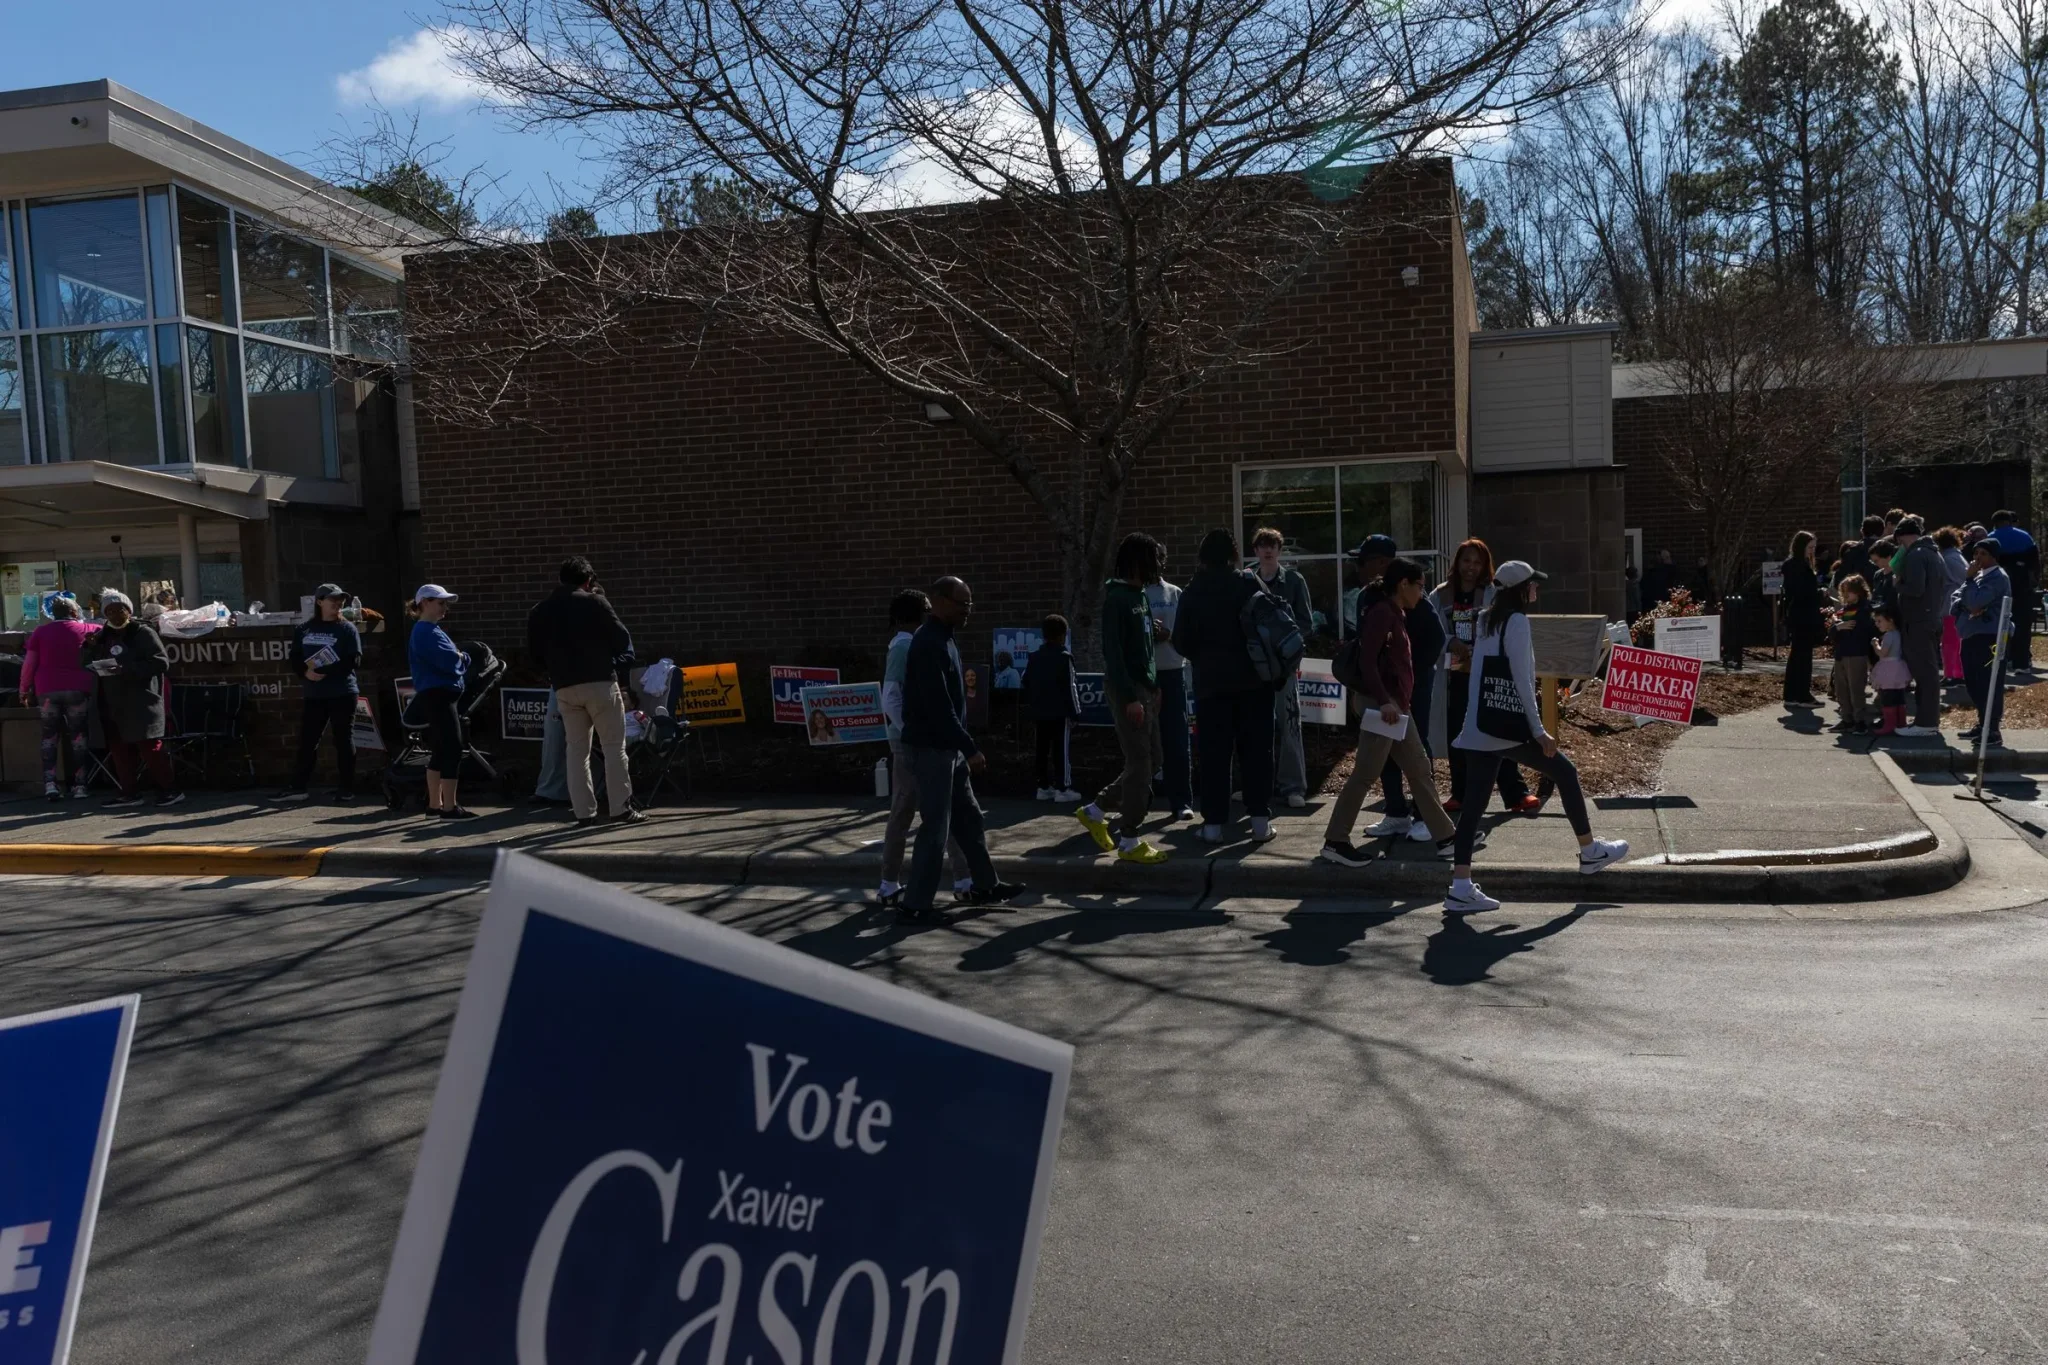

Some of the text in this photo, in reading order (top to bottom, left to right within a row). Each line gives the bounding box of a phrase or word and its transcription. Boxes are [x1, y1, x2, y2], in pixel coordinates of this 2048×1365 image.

[1613, 648, 1699, 674] POLL DISTANCE
[1608, 667, 1694, 701] MARKER
[809, 694, 874, 708] MORROW
[1305, 701, 1328, 709] SENATE
[1611, 689, 1686, 710] NO ELECTIONEERING
[1611, 701, 1683, 721] BEYOND THIS POINT
[832, 716, 879, 727] US Senate
[746, 1042, 893, 1155] Vote
[708, 1169, 825, 1233] Xavier
[516, 1148, 961, 1365] Cason
